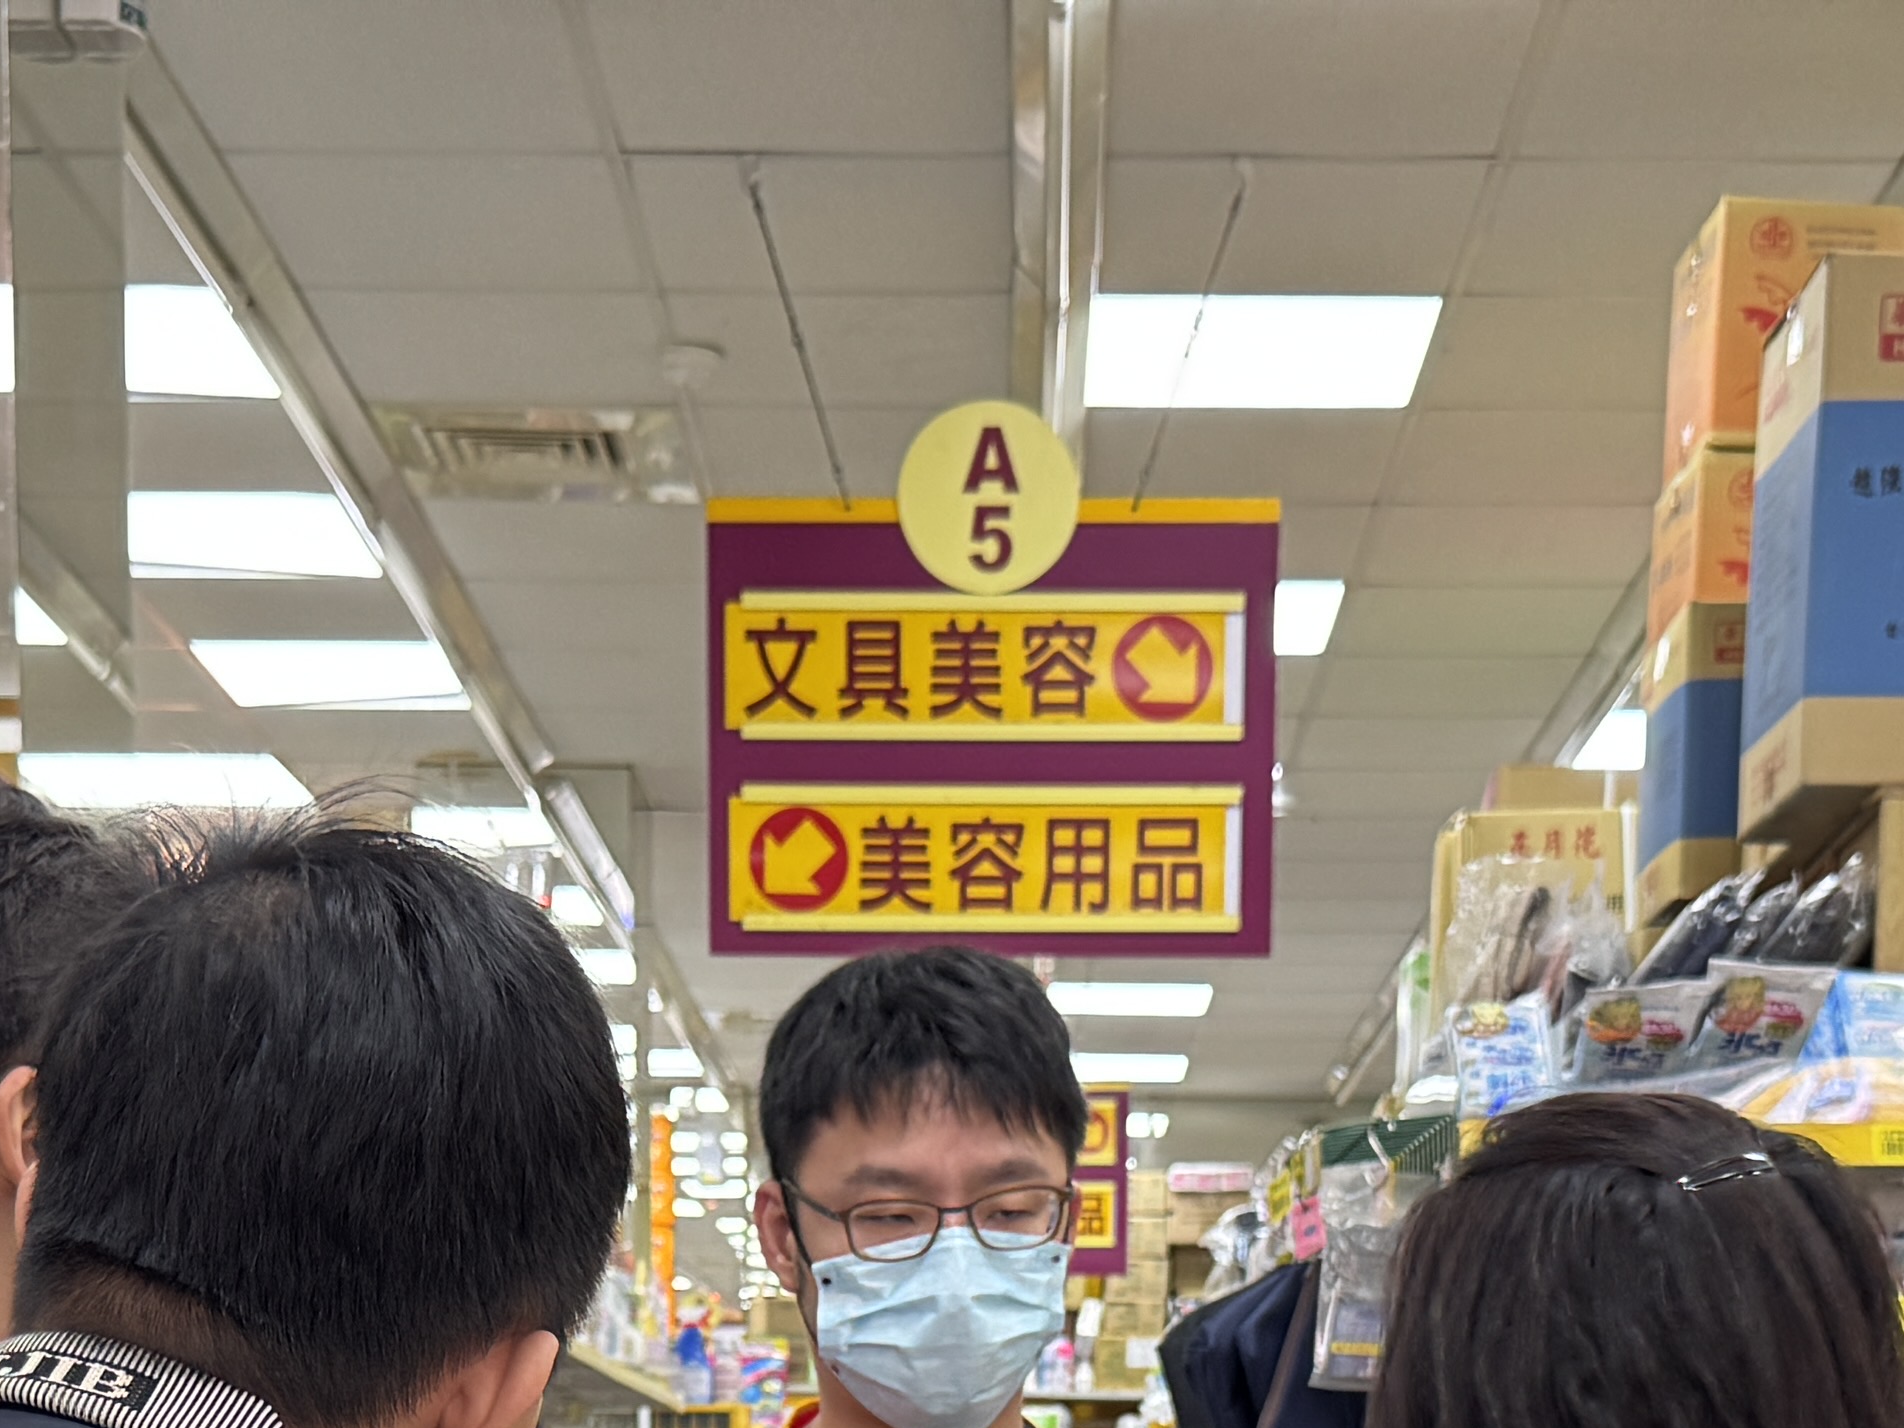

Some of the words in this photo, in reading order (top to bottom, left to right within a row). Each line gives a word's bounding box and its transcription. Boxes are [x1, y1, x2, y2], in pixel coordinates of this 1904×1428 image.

[963, 426, 1019, 493] A
[969, 505, 1011, 573] 5
[744, 618, 1096, 719] 文具美容
[859, 816, 1203, 914] 美容用品
